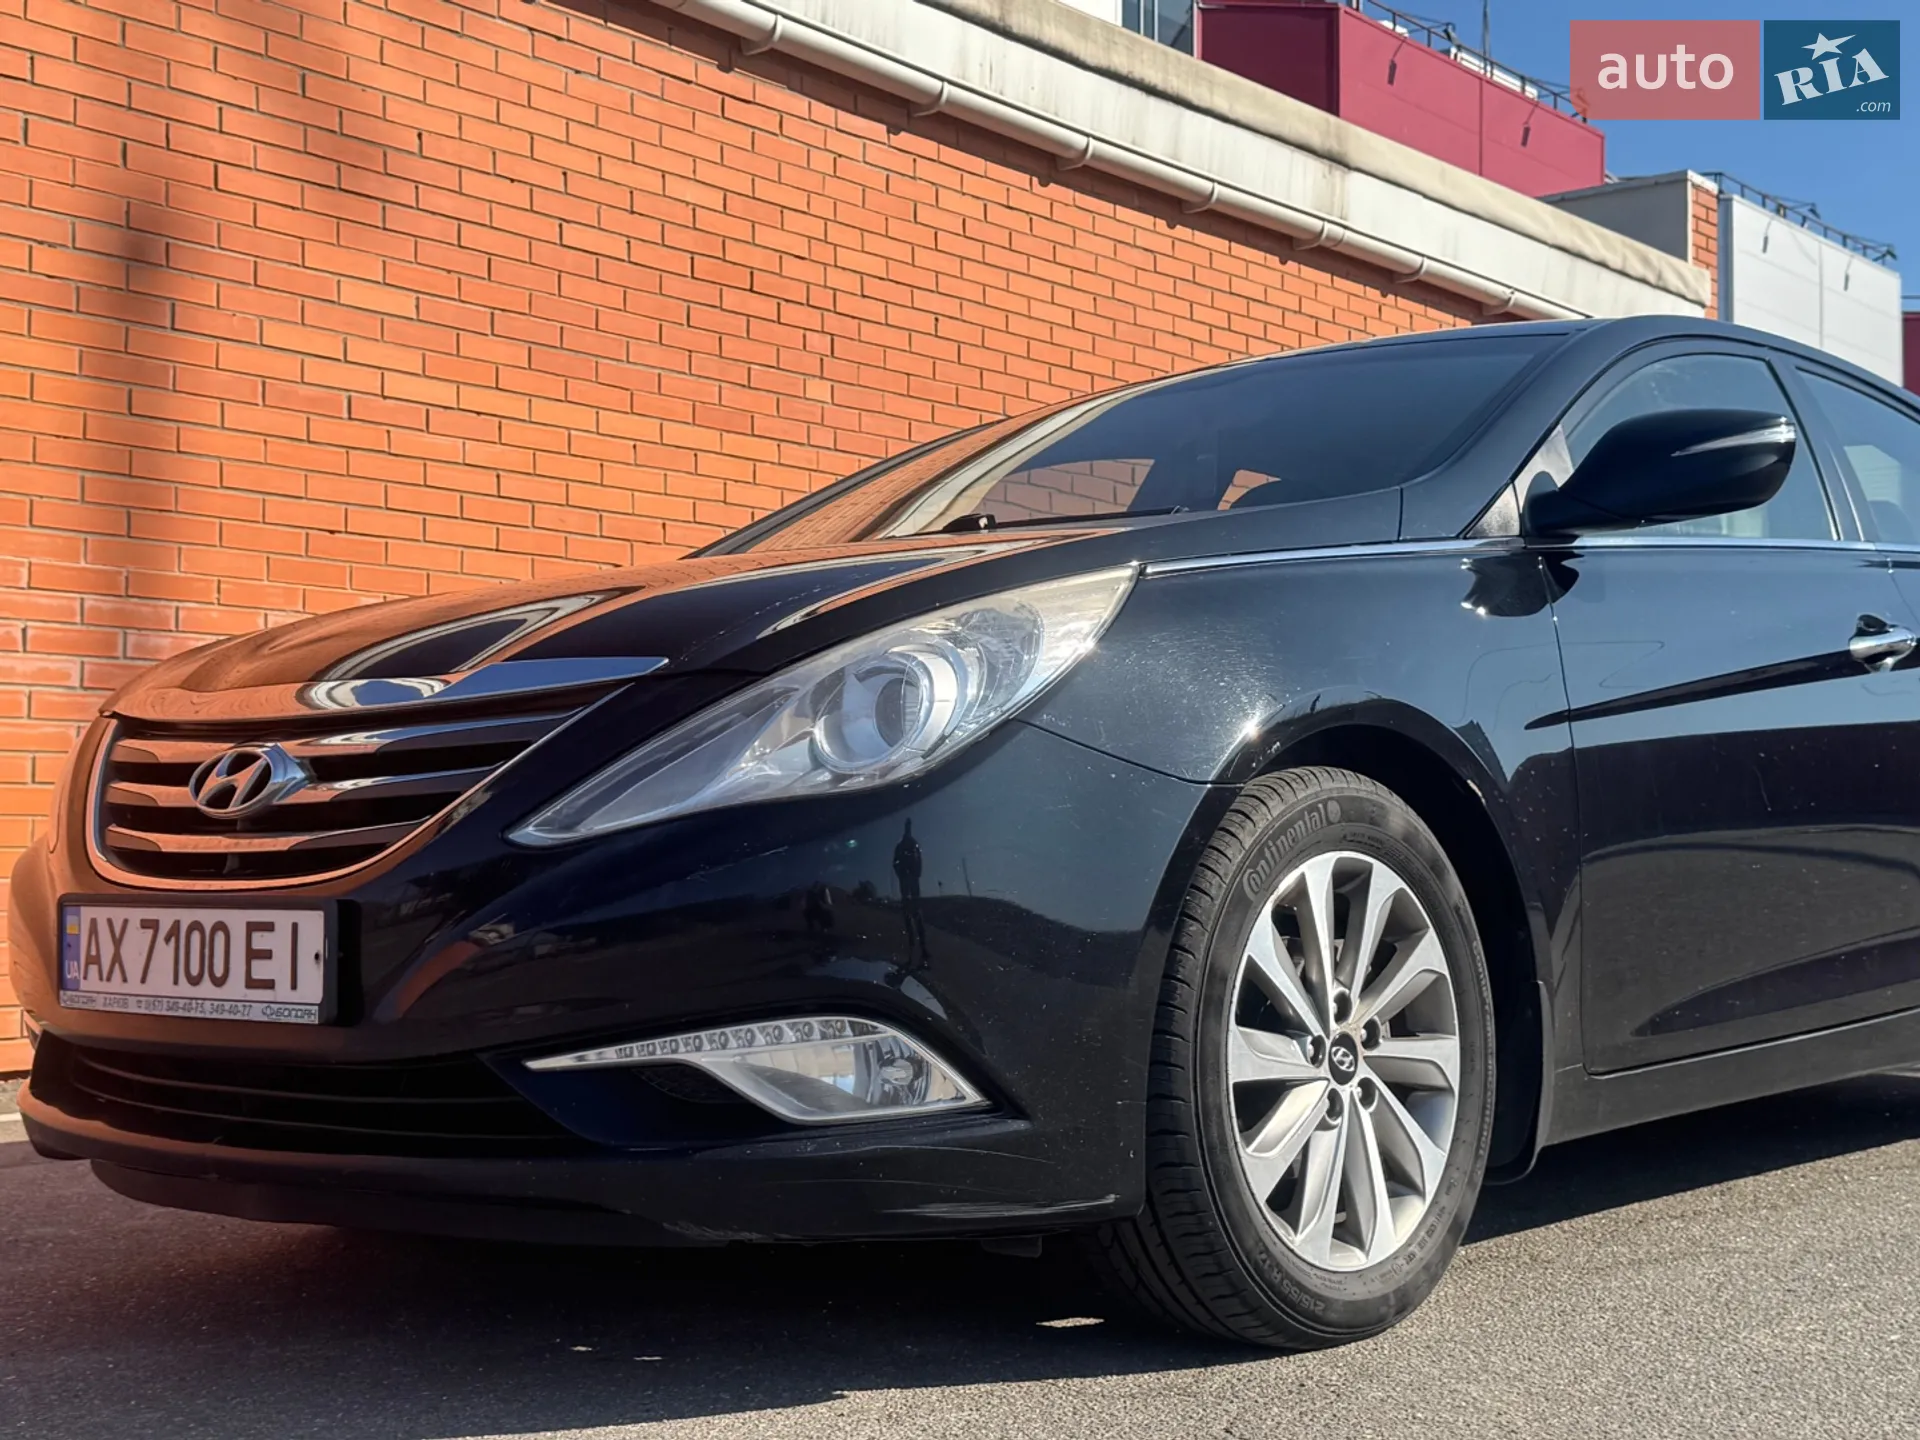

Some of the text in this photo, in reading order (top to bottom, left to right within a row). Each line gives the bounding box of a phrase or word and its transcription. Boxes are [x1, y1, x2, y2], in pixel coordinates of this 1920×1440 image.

[1243, 803, 1328, 900] Continental
[65, 960, 80, 980] UA
[83, 917, 299, 990] AX 7100 EI
